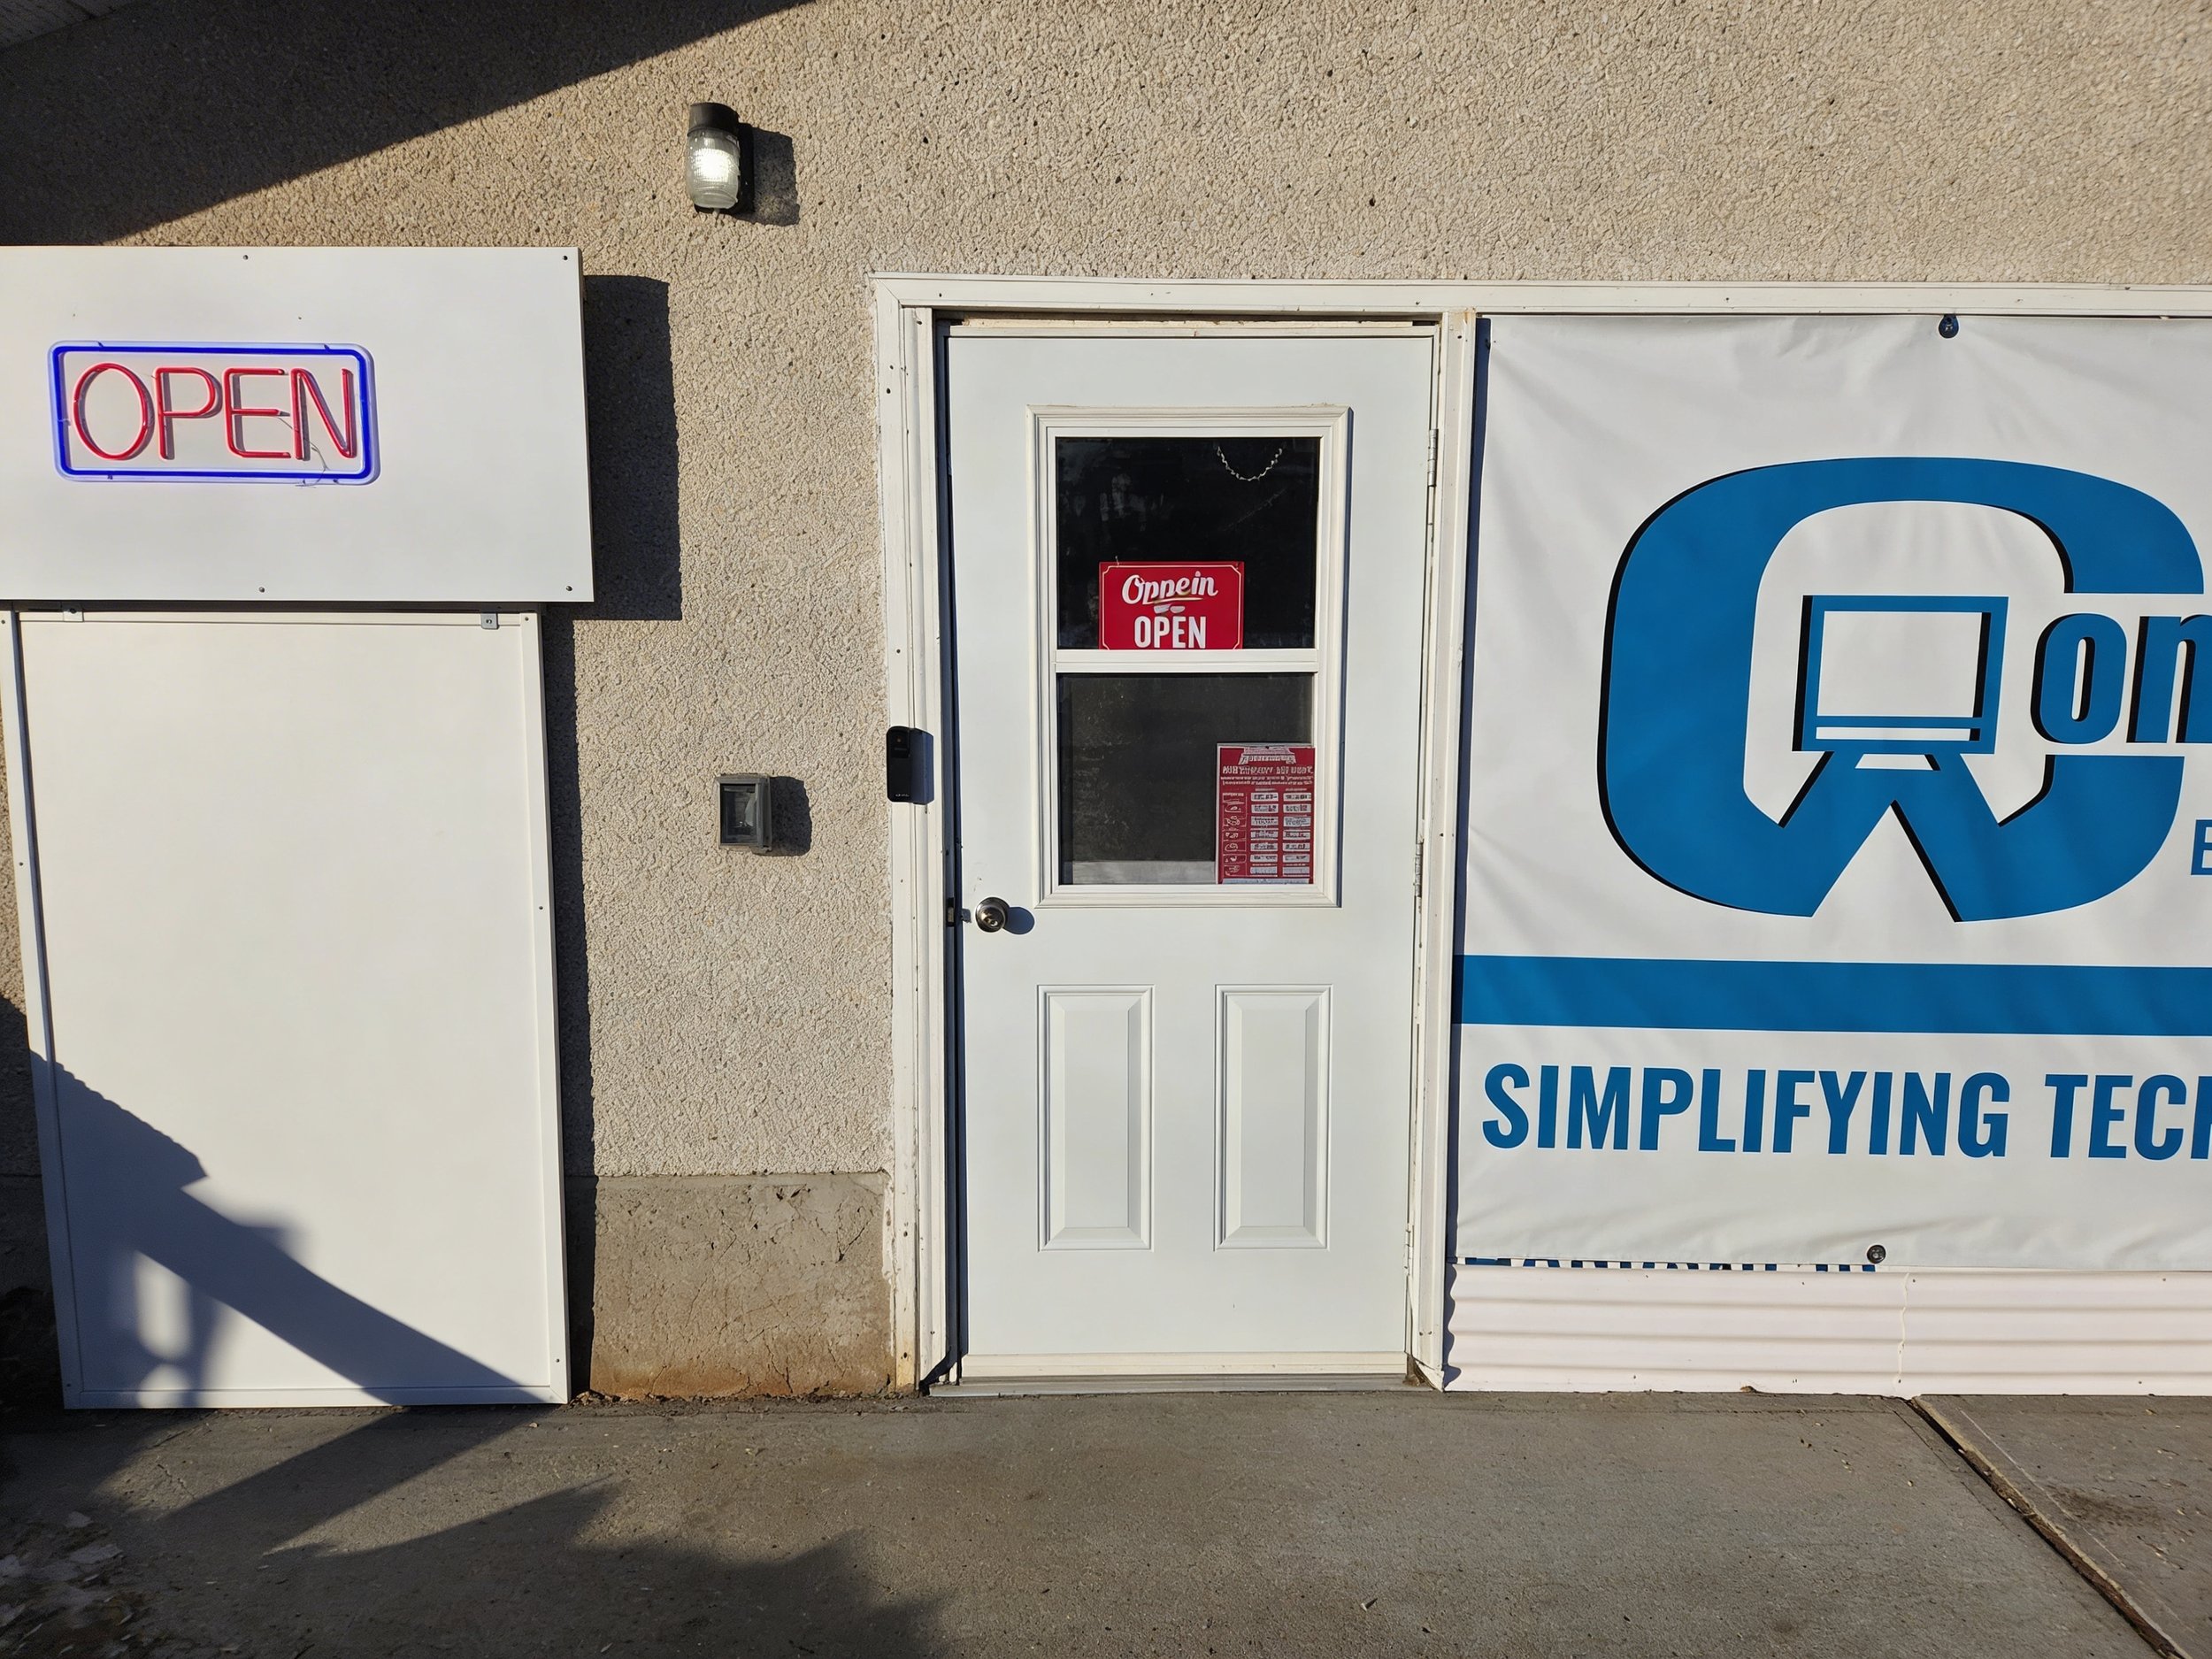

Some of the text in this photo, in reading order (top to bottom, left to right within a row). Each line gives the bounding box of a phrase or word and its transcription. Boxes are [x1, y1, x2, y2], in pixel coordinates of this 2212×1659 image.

[73, 362, 357, 461] OPEN
[1134, 616, 1206, 649] OPEN
[1481, 1063, 2010, 1158] SIMPLIFYING
